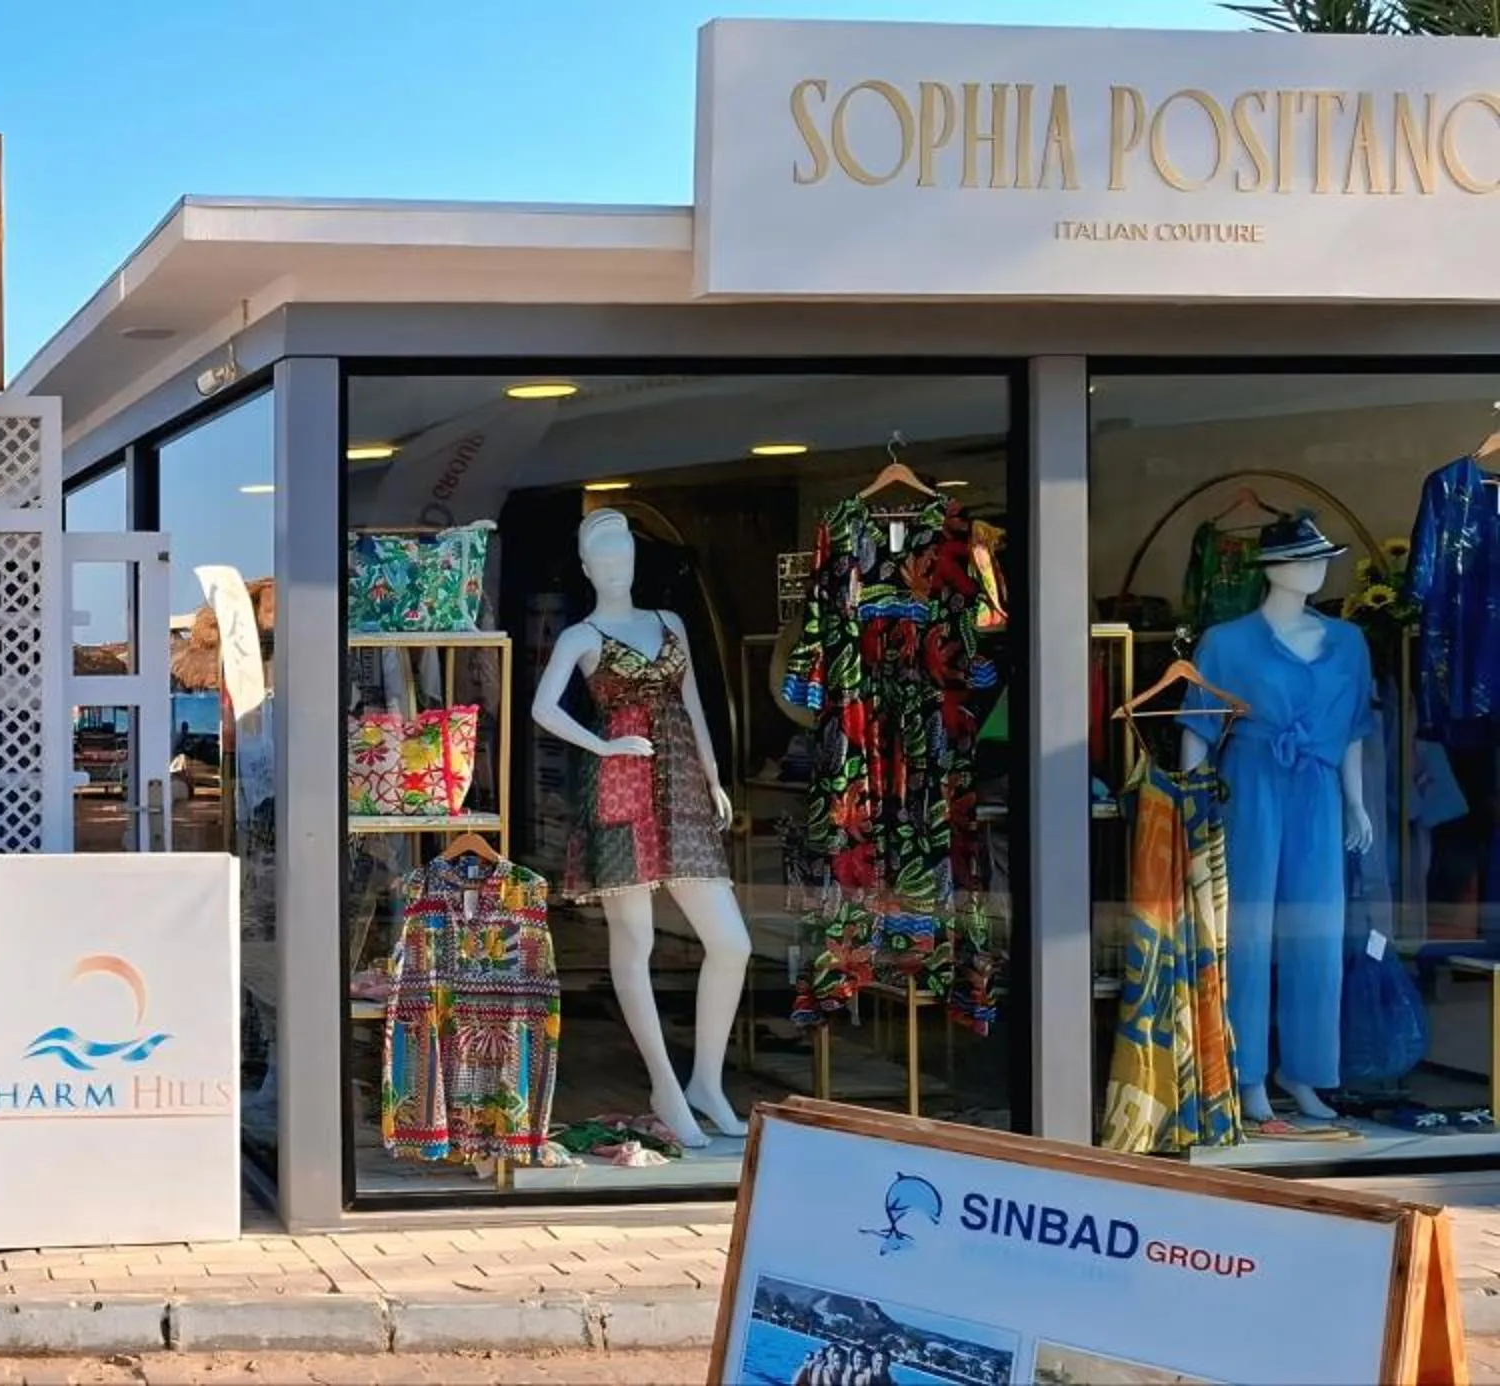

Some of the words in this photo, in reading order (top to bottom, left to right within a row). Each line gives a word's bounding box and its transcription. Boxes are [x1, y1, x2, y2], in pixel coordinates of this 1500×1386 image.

[790, 79, 1080, 191] SOPHIA
[1108, 84, 1500, 195] POSITANO
[1054, 220, 1149, 241] ITALIAN
[1155, 222, 1265, 243] COUTURE
[133, 1074, 232, 1109] HILLS
[960, 1192, 1140, 1260] SINBAD
[1146, 1240, 1256, 1278] GROUP
